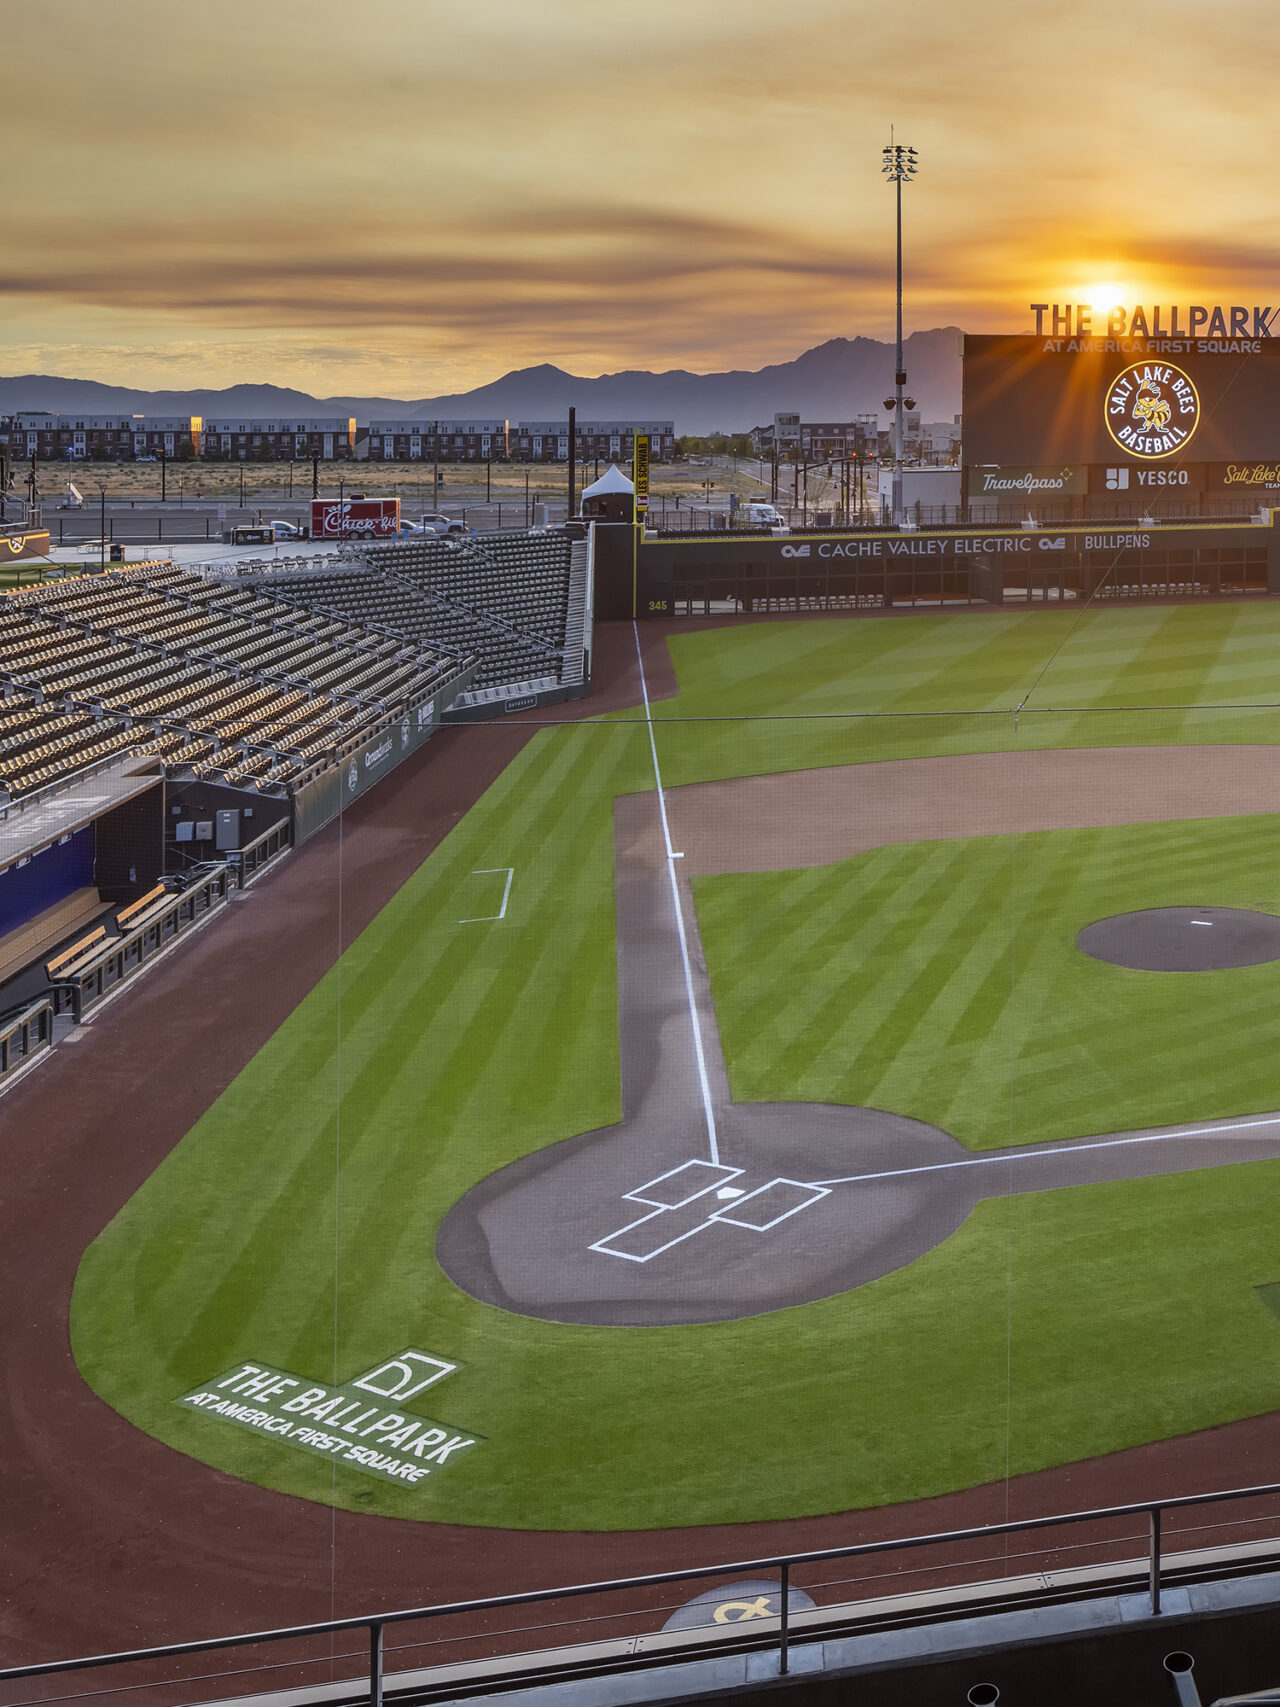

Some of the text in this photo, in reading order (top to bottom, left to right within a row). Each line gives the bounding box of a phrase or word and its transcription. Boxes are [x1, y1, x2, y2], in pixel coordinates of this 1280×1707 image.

[1030, 304, 1273, 337] THE BALLPARK
[1043, 340, 1262, 354] AT AMERICA FIRST SQUARE
[1110, 366, 1195, 414] SALT LAKE BEES
[1118, 425, 1187, 453] BASEBALL
[983, 472, 1063, 494] Travelpass
[1136, 470, 1189, 485] YESCO
[1223, 464, 1250, 484] Salt
[1245, 464, 1276, 485] Lake
[818, 542, 882, 558] CACHE
[888, 540, 948, 555] VALLEY
[954, 538, 1032, 553] ELECTRIC
[1084, 534, 1150, 549] BULLPENS
[648, 600, 668, 611] 345
[217, 1365, 476, 1465] THE BALLPARK
[183, 1391, 431, 1483] AT AMERICA FIRST SQUARE
